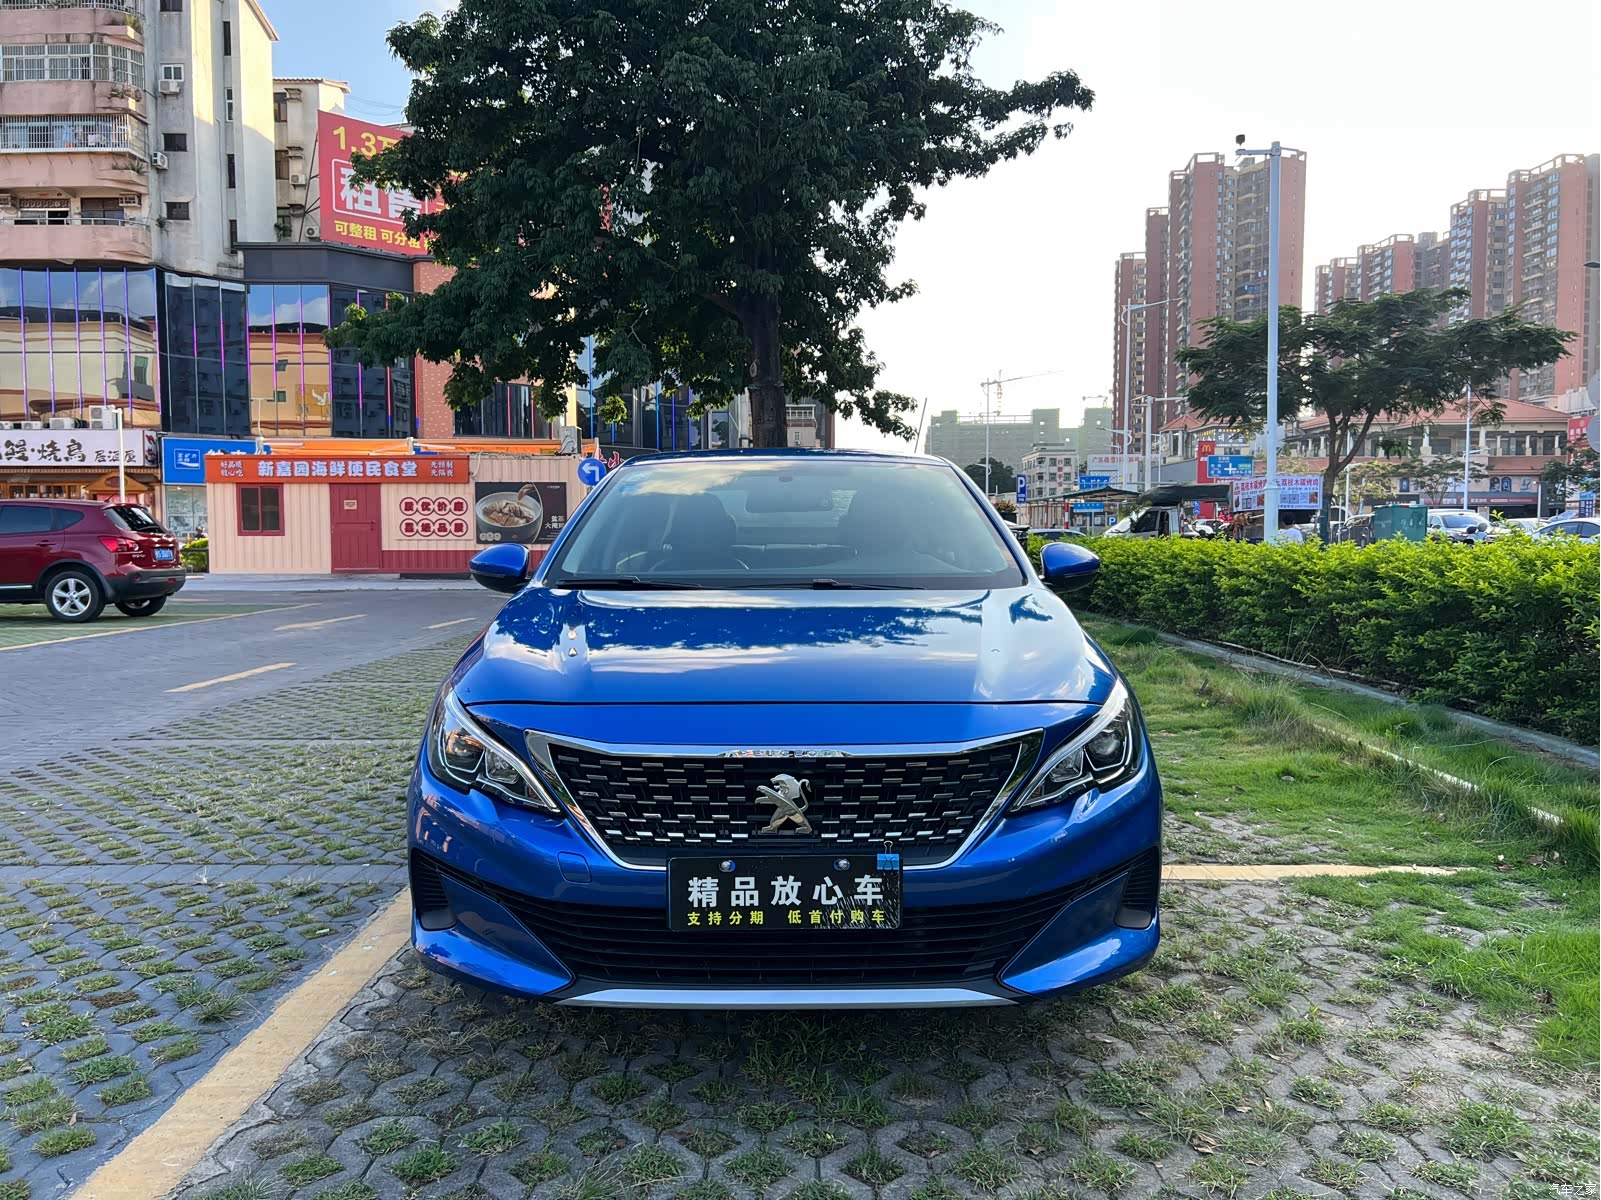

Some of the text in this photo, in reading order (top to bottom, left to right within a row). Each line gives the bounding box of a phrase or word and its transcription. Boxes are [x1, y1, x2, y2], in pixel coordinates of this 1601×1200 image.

[334, 220, 377, 241] 可整租
[257, 460, 418, 477] 新嘉园海鲜便民食堂
[1017, 476, 1026, 494] P
[1108, 516, 1116, 526] P
[687, 875, 884, 908] 精品放心车
[687, 910, 885, 926] 支持分期 低首付购车
